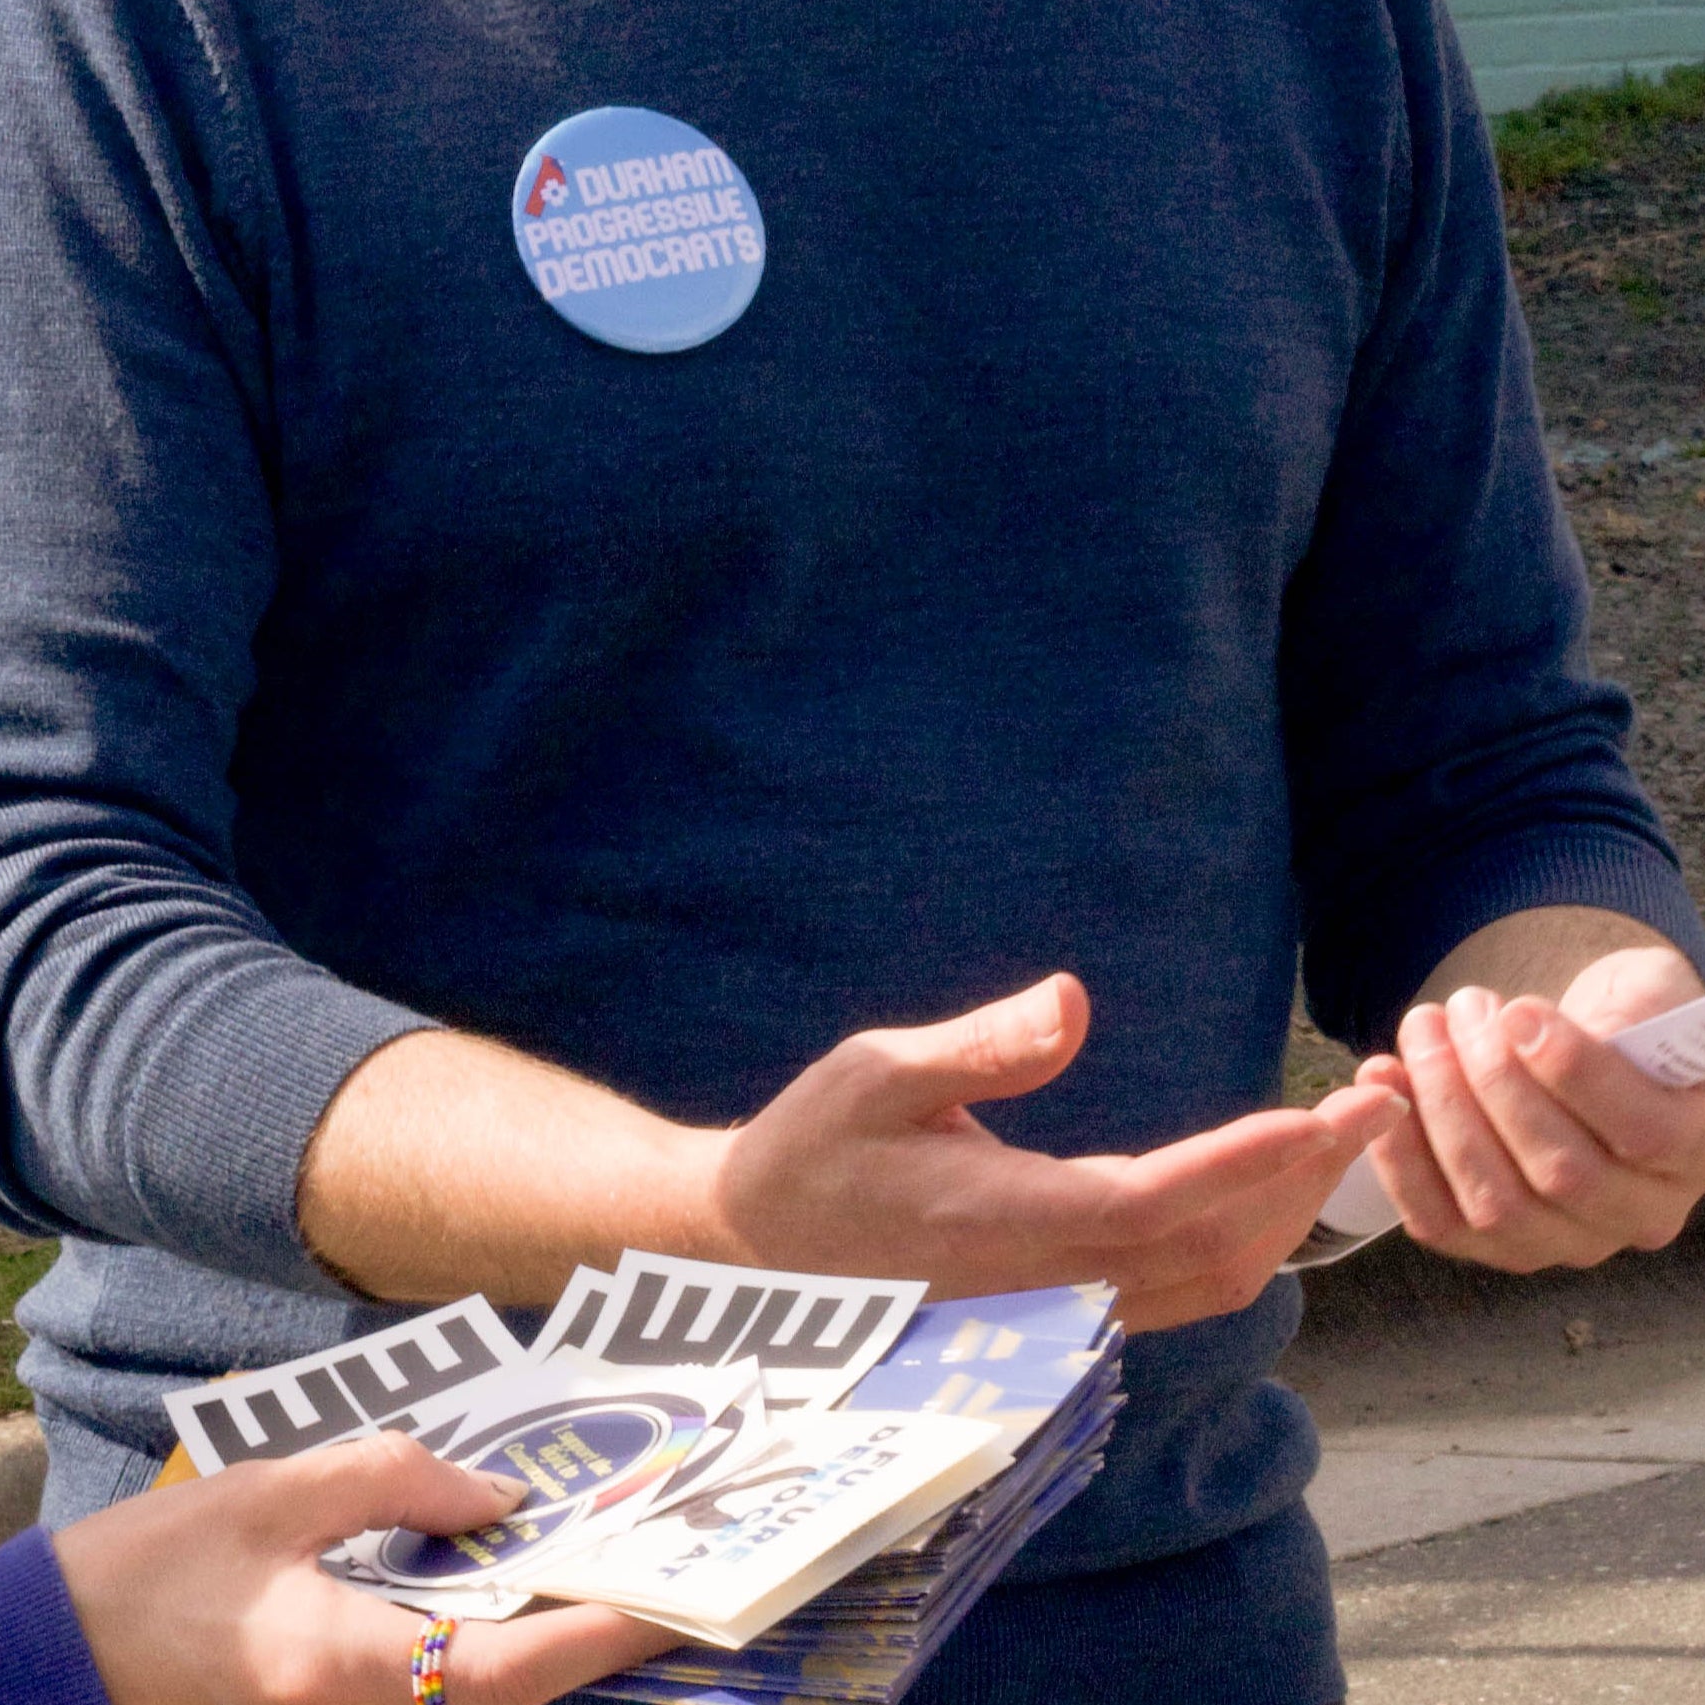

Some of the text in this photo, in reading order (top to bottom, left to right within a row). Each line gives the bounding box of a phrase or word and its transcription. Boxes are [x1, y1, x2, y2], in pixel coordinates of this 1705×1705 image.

[575, 147, 735, 206] DURHAM
[524, 187, 749, 258] PROGRESSIVE
[535, 224, 762, 301] DEMOCRATS
[658, 1426, 906, 1580] DEMOCRAT
[716, 1451, 901, 1563] FUTURE
